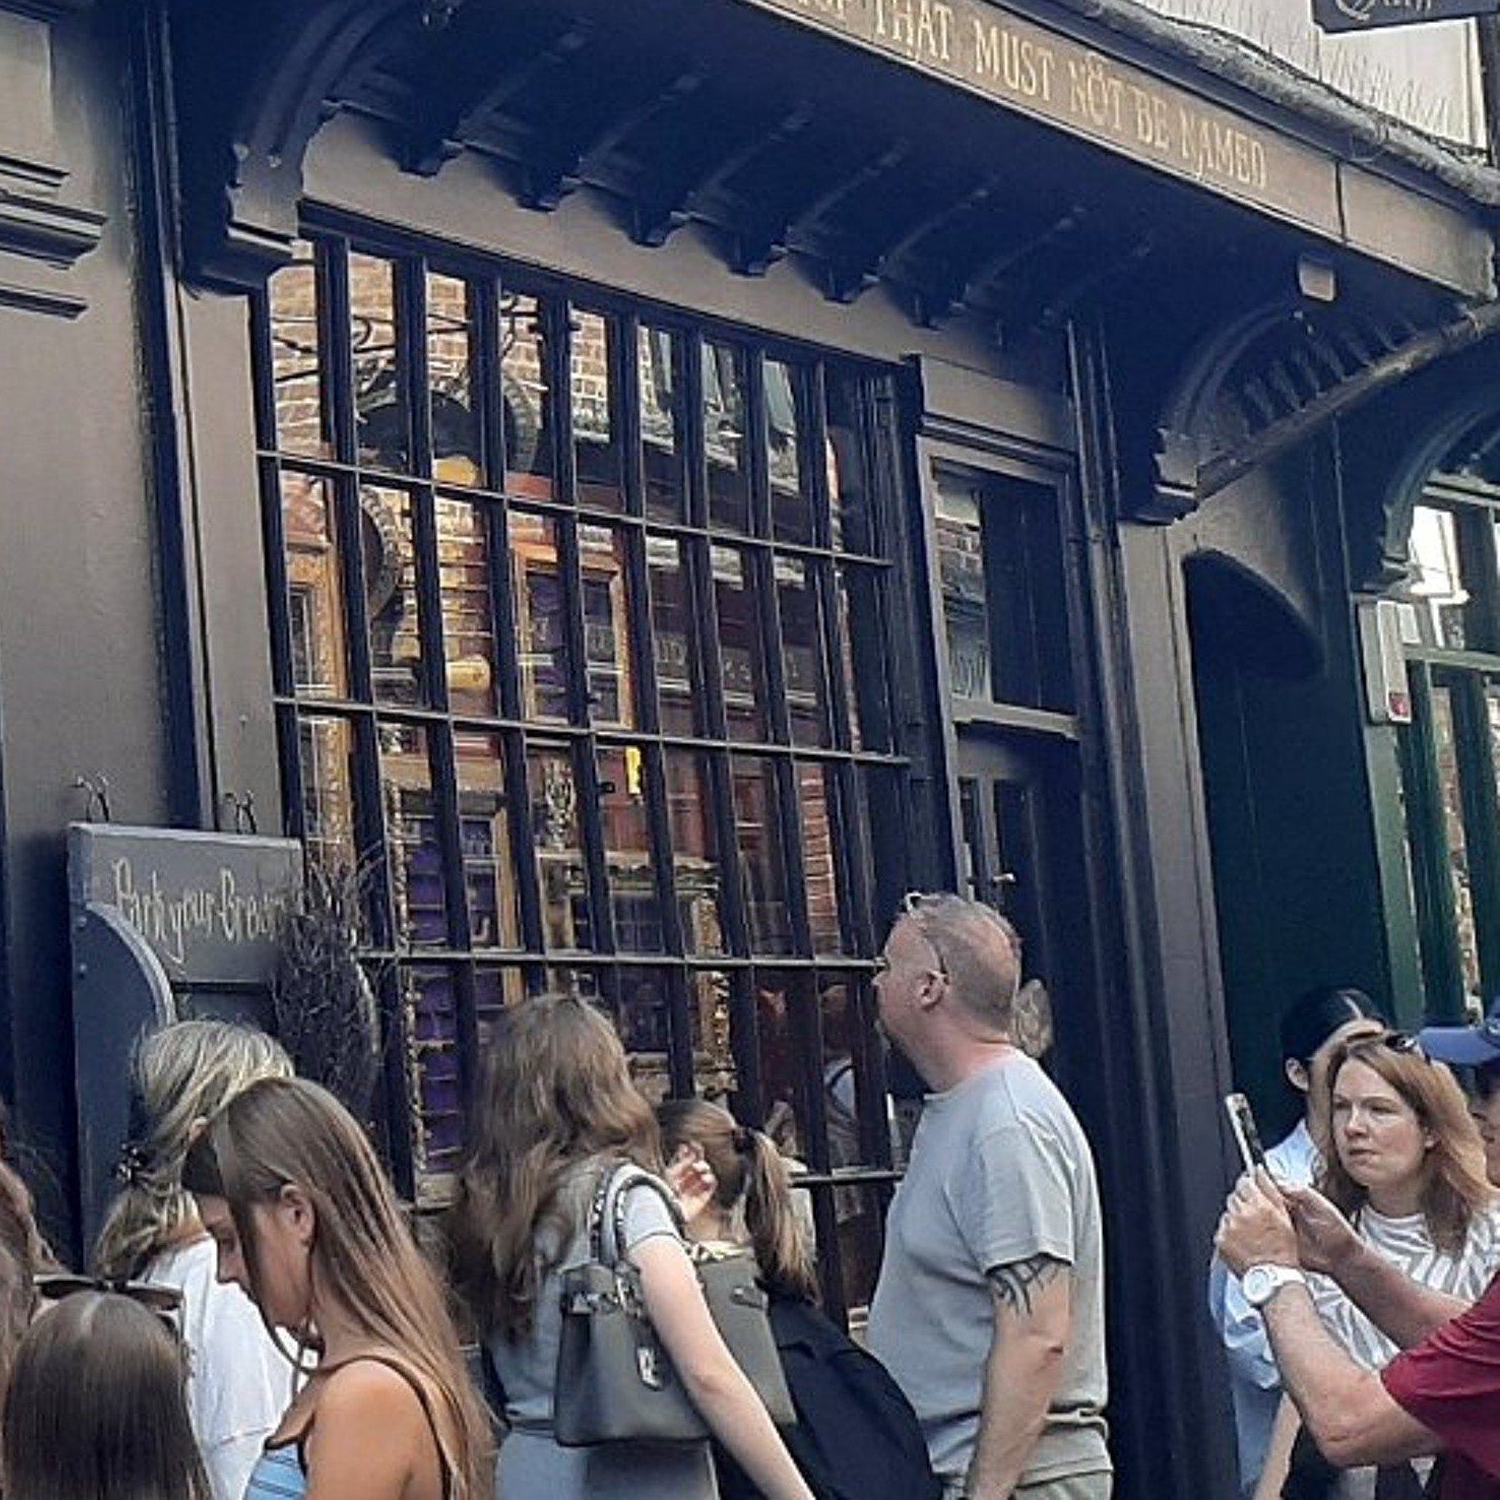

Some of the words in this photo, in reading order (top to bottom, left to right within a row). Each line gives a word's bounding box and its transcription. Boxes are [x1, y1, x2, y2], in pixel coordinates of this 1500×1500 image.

[973, 18, 1055, 102] MUST
[1068, 53, 1125, 132] NOT
[1132, 84, 1171, 152] BE
[1179, 106, 1269, 190] NAMED
